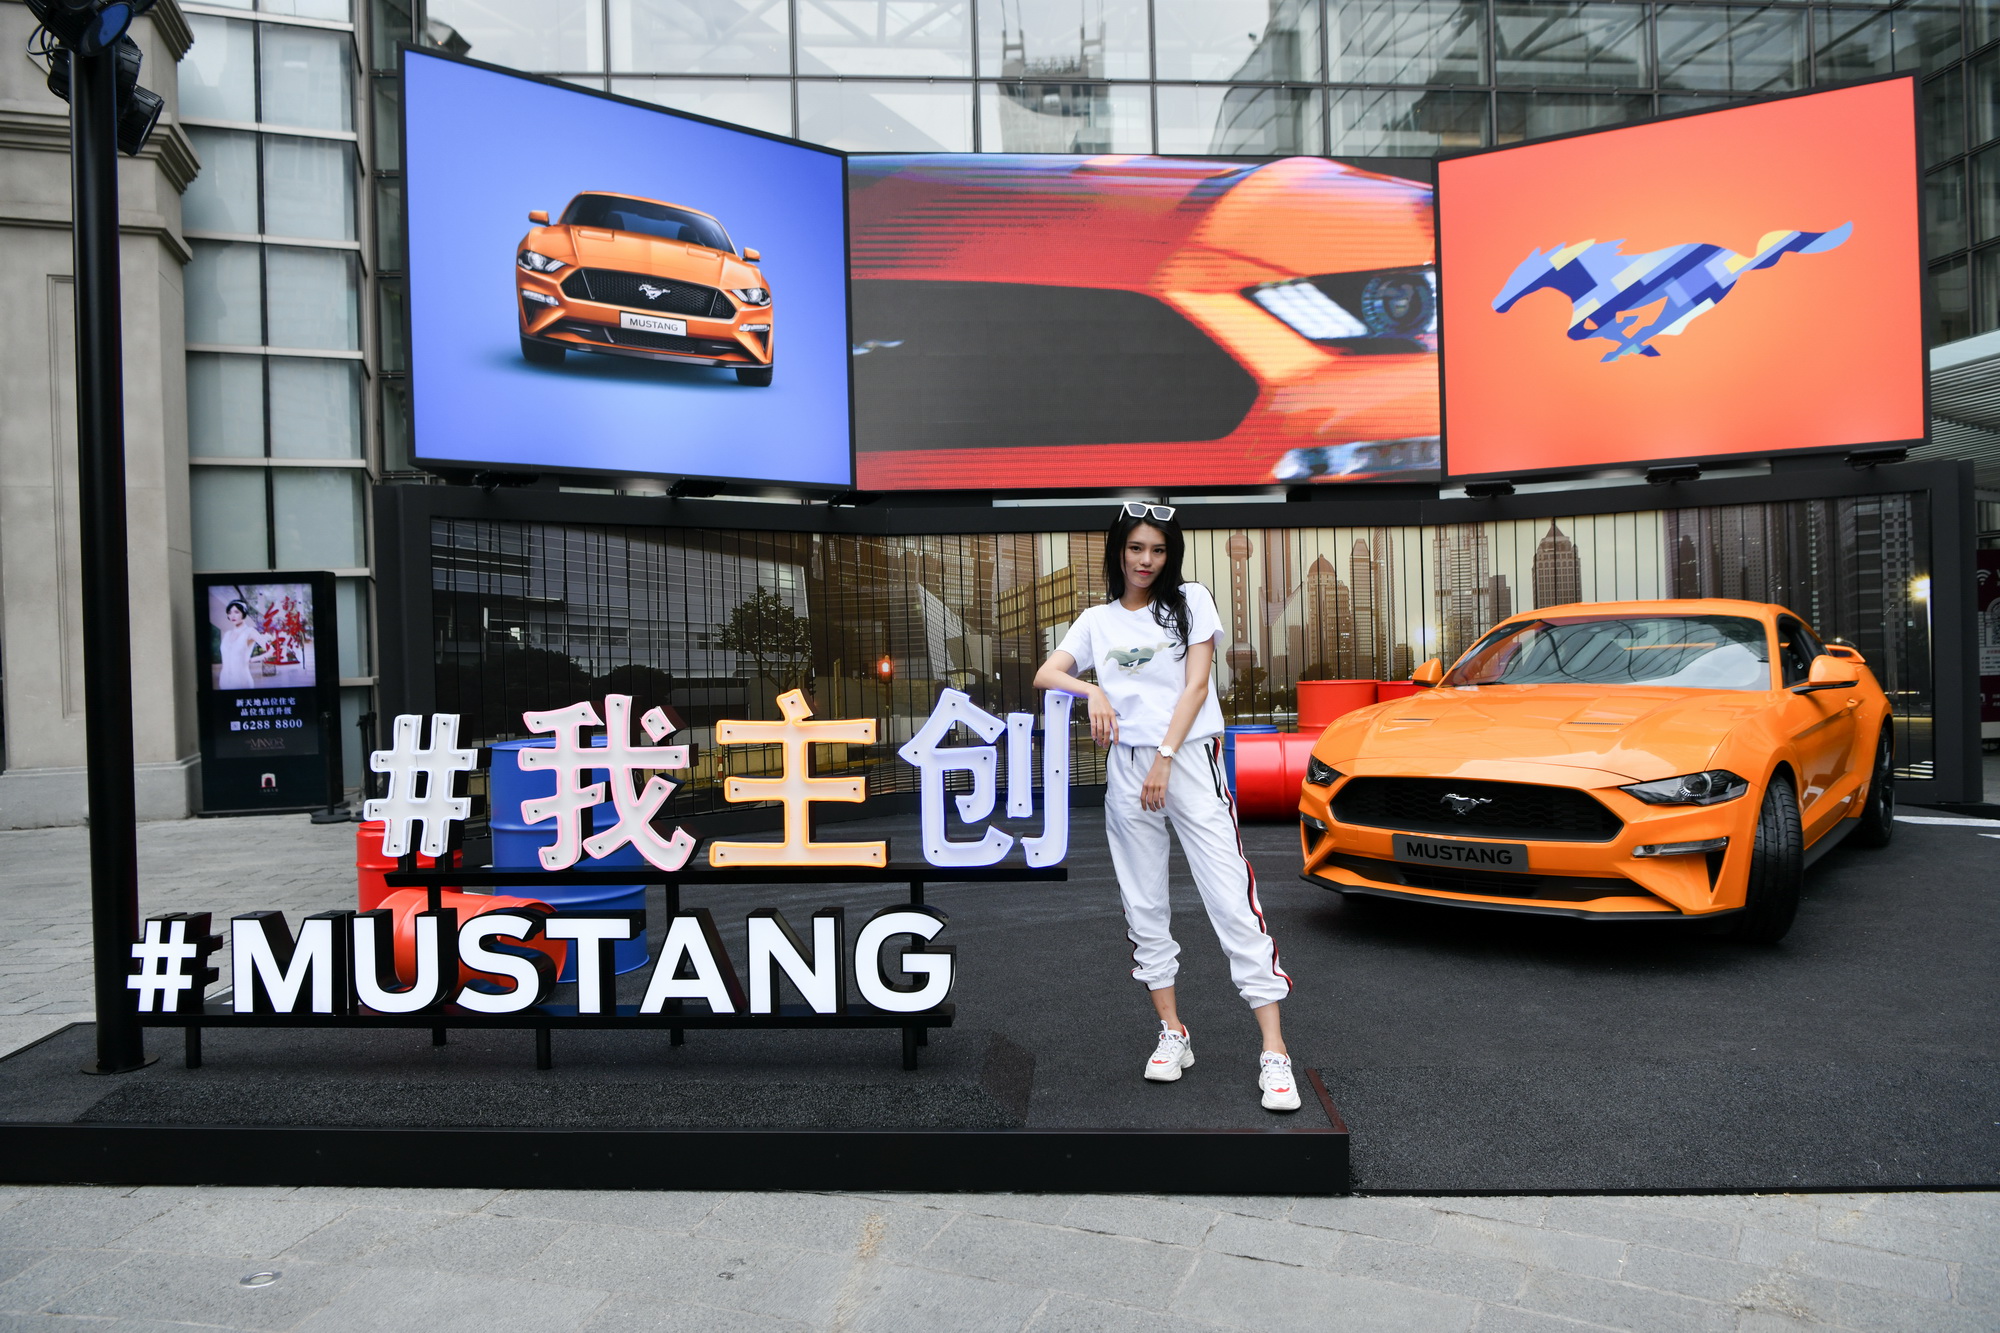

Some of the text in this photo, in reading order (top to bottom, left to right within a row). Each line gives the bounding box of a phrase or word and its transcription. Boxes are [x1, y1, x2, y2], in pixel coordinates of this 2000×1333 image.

[629, 318, 678, 331] MUSTANG
[242, 718, 303, 730] 6288 8800
[1406, 841, 1513, 865] MUSTANG
[127, 911, 952, 1014] #MUSTANG
